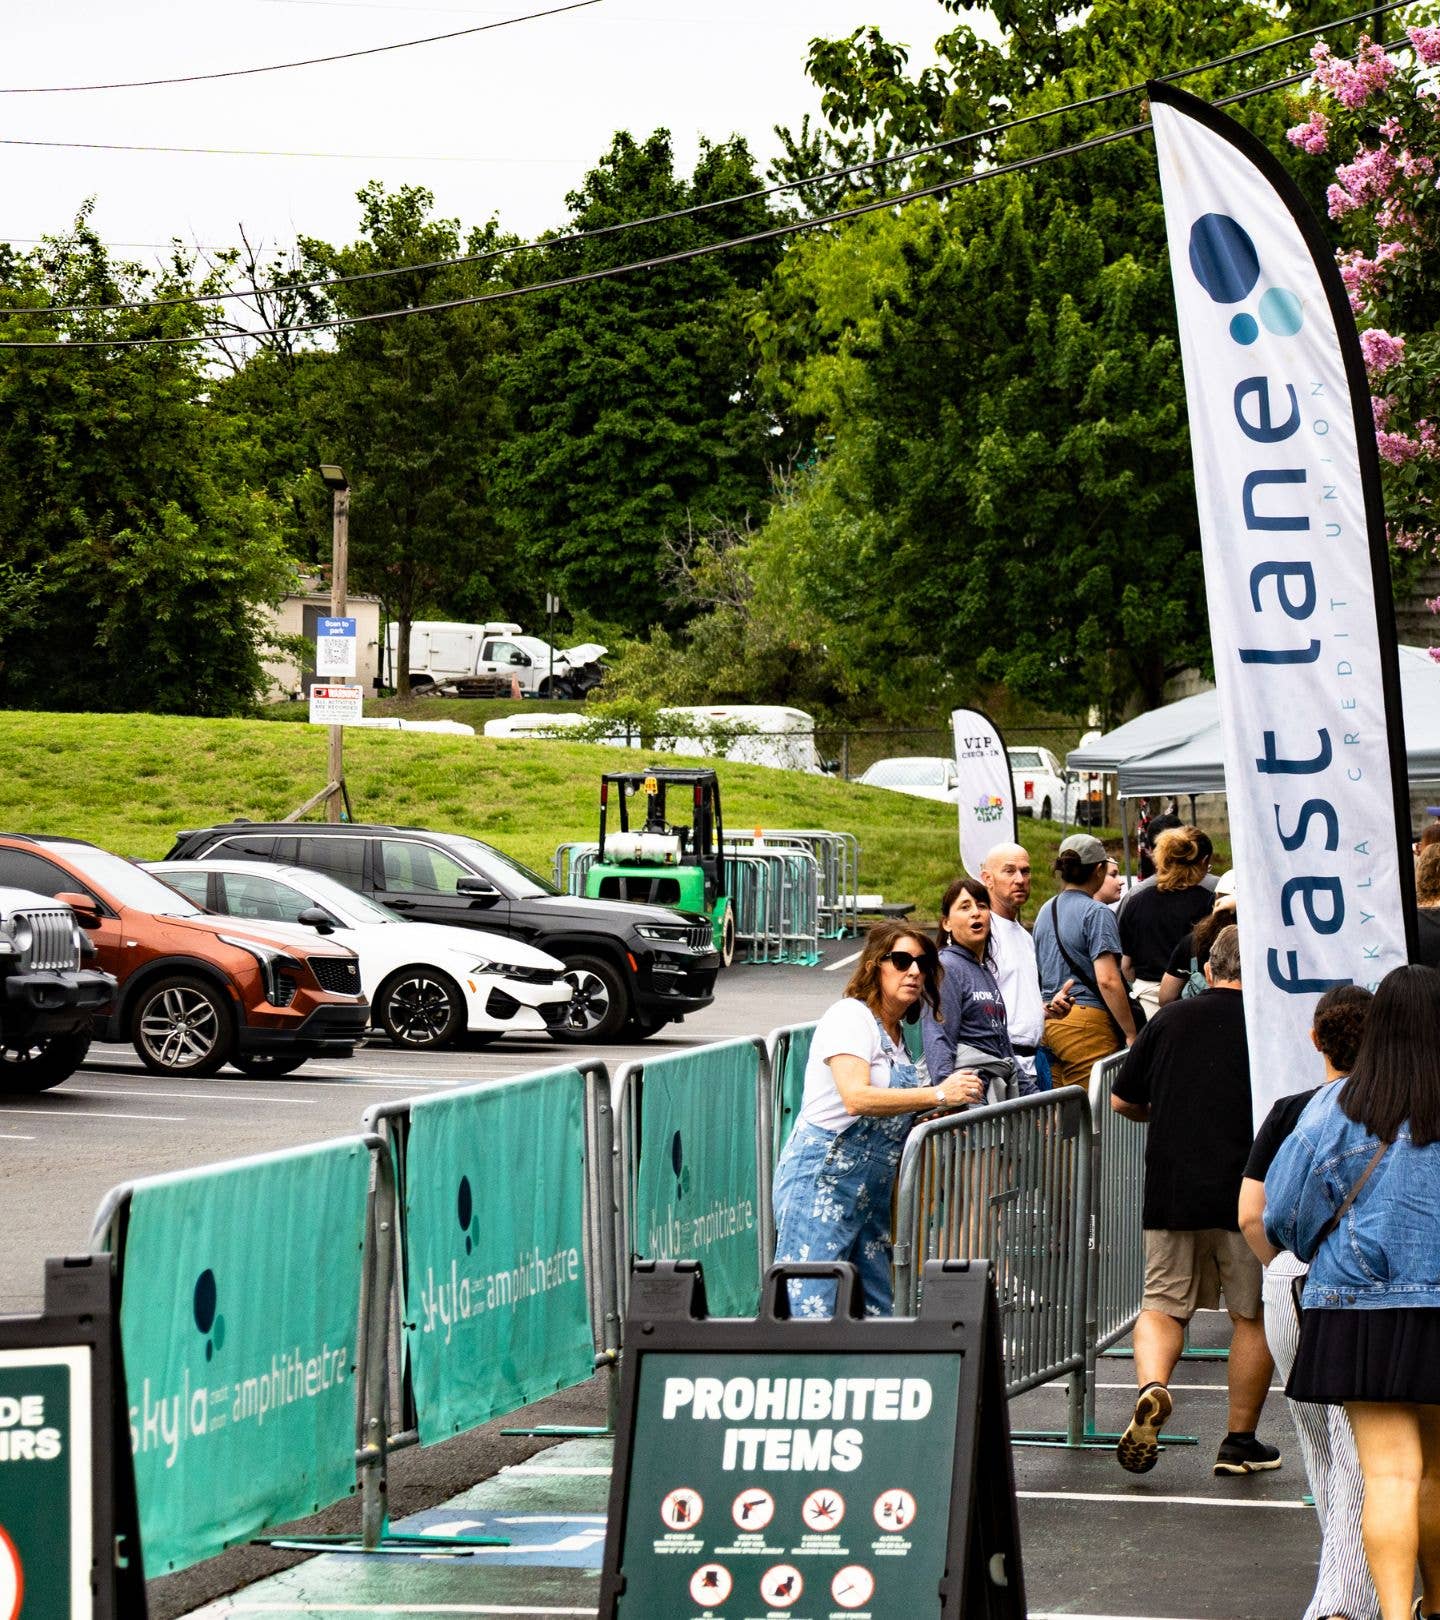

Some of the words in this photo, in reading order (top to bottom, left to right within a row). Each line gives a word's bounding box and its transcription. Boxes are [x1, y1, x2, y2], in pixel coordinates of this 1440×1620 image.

[1311, 381, 1342, 538] UNION
[1233, 376, 1321, 665] lane
[964, 736, 992, 750] VIP
[1330, 598, 1364, 782] CREDIT
[1256, 727, 1354, 995] fast
[232, 1343, 347, 1426] amphitheatre
[662, 1377, 934, 1421] PROHIBITED
[721, 1428, 865, 1473] ITEMS
